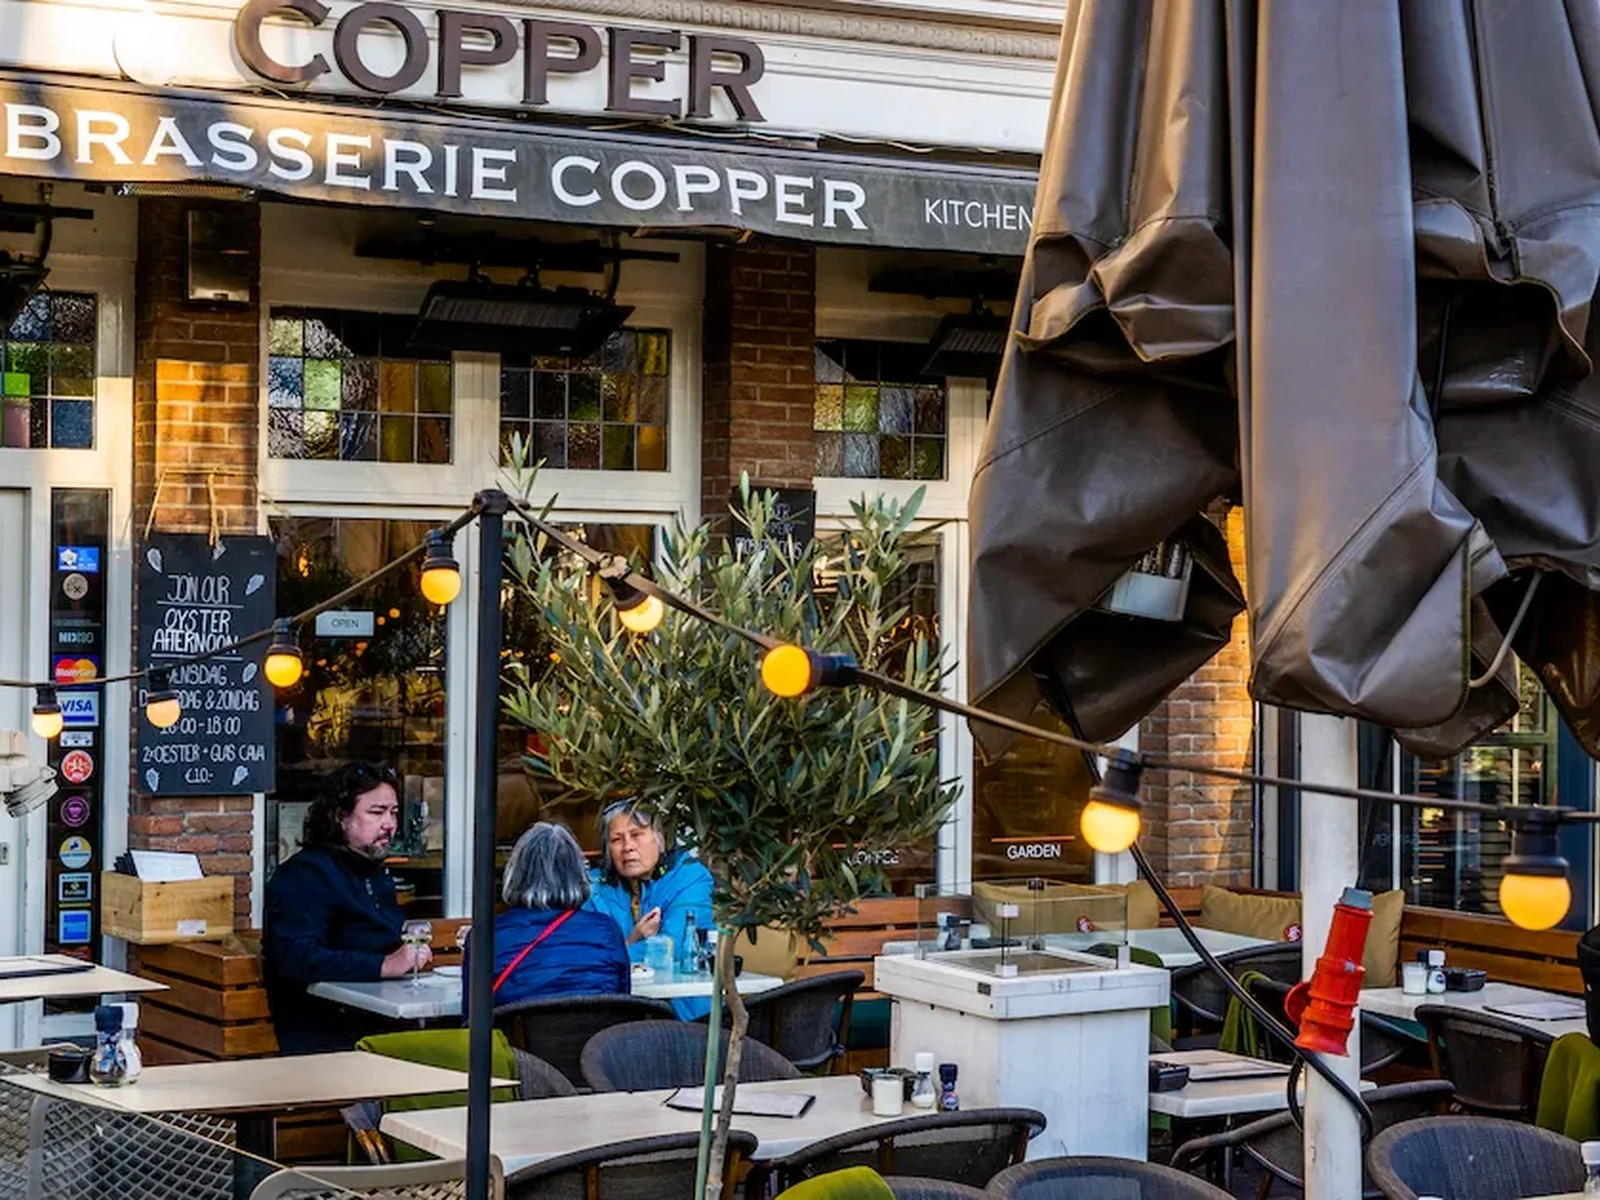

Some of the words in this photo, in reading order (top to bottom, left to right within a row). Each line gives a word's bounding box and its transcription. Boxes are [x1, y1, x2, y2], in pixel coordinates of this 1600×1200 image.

[235, 0, 767, 122] COPPER
[4, 102, 519, 203] BRASSERIE
[550, 155, 868, 231] COPPER
[925, 198, 1036, 230] KITCHEN
[165, 608, 231, 633] OYSTER
[330, 618, 359, 628] OPEN
[62, 700, 93, 712] VISA
[1007, 844, 1061, 859] GARDEN
